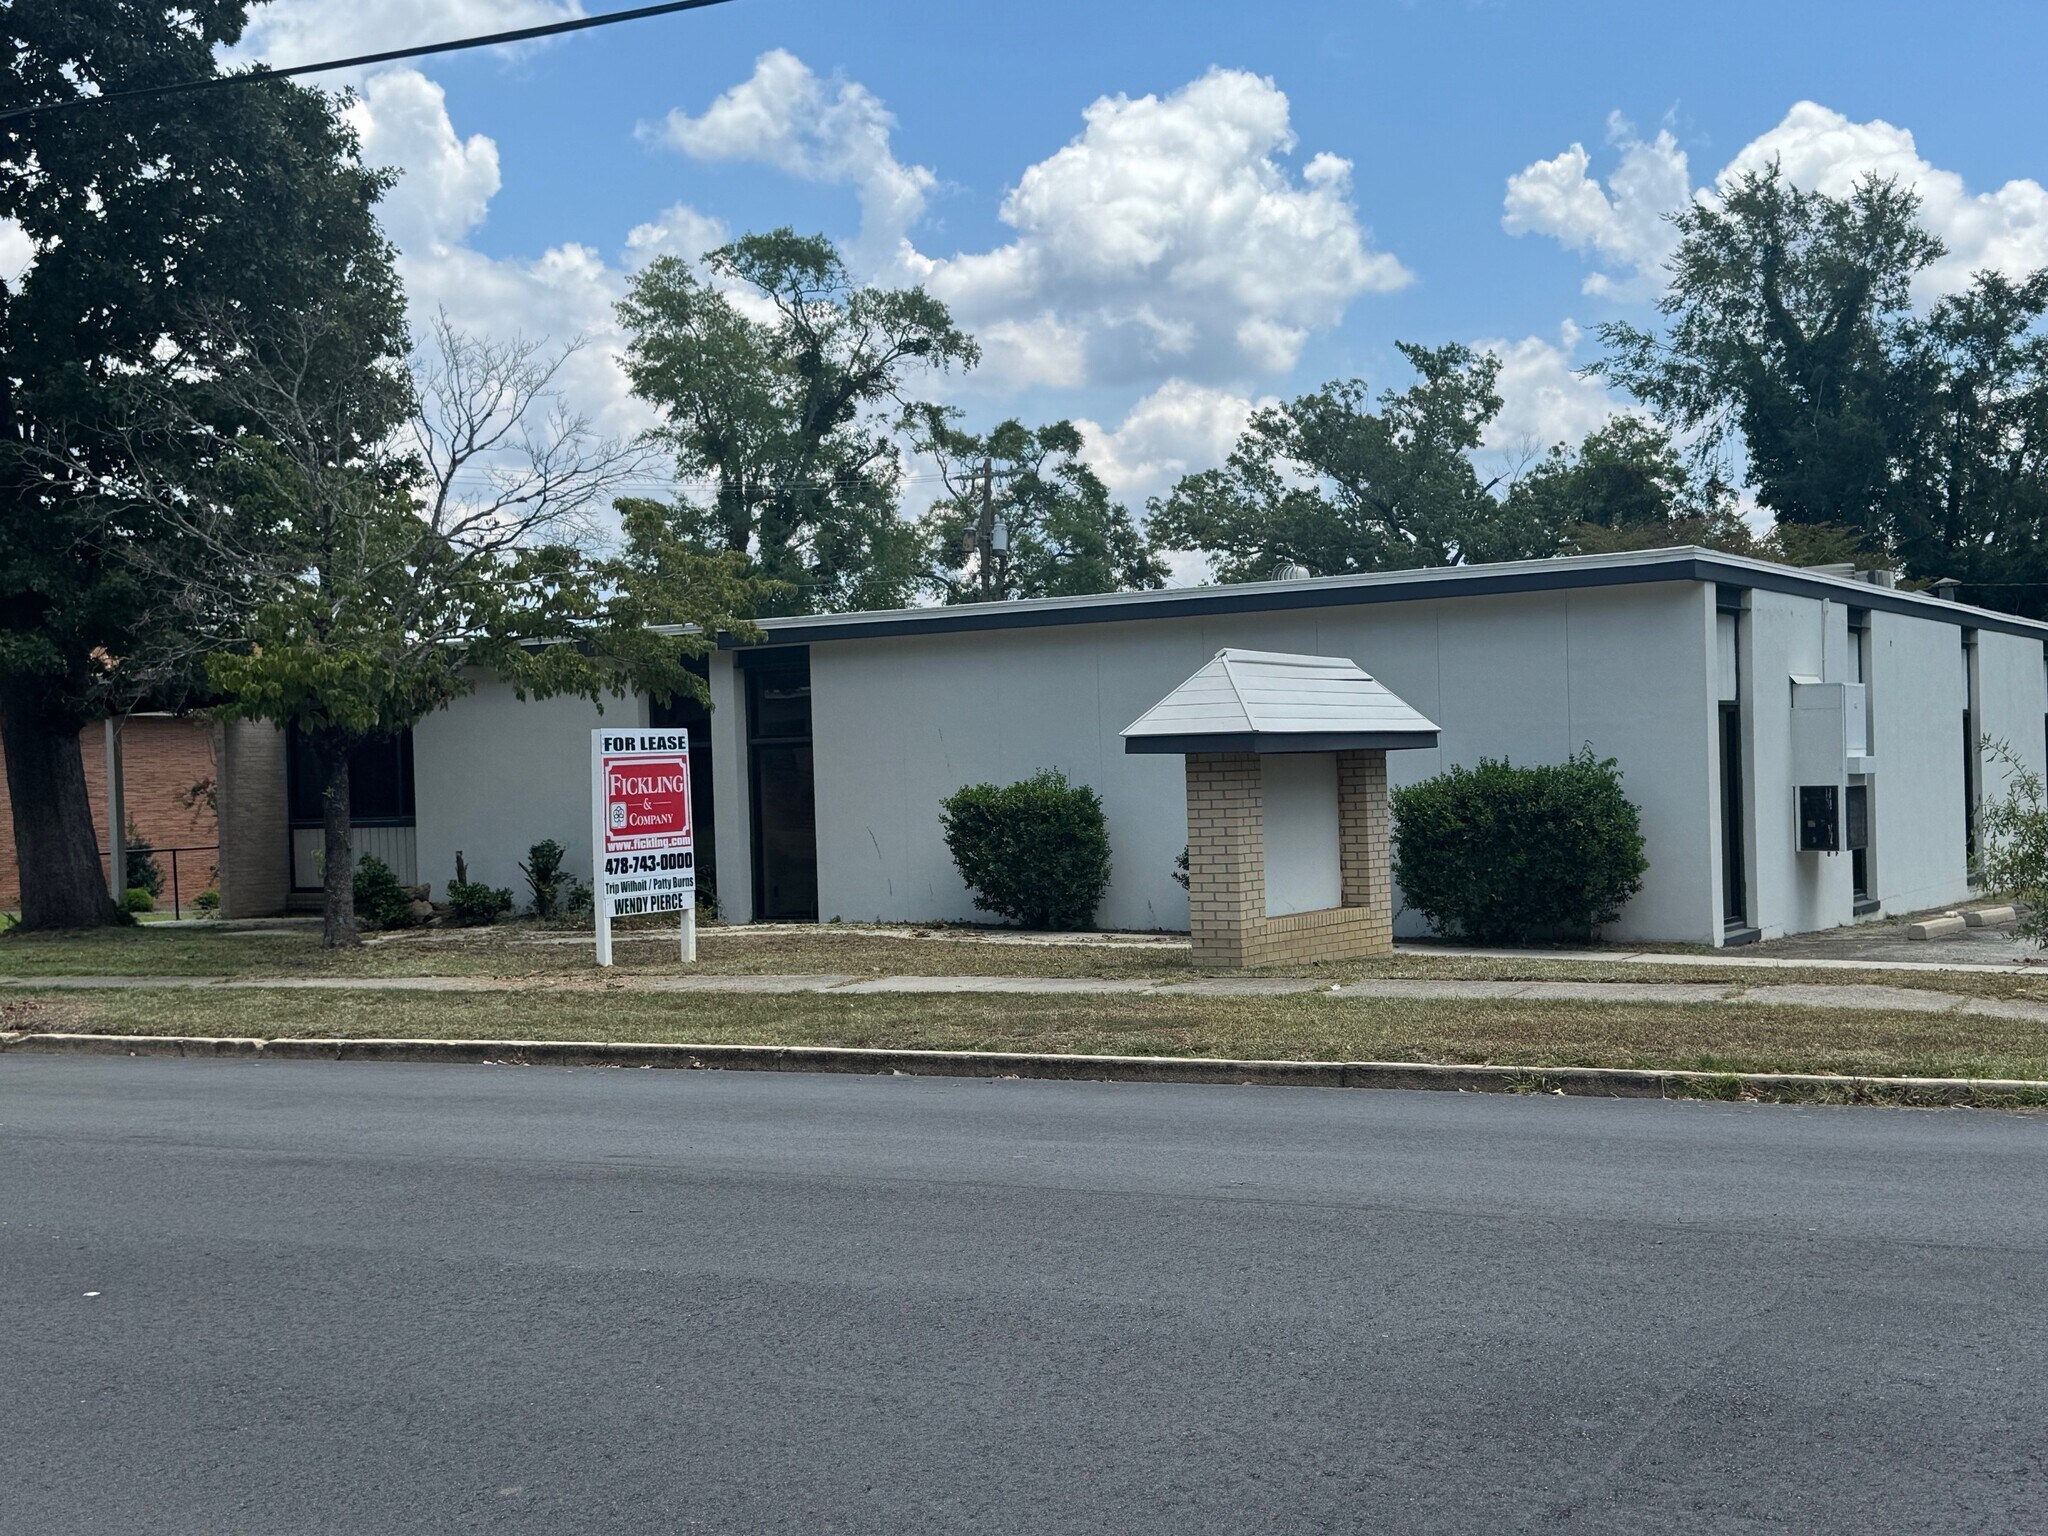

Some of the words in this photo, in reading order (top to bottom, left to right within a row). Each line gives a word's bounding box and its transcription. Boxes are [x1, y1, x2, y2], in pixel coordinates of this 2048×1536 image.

[604, 737, 635, 752] FOR
[640, 736, 686, 750] LEASE
[610, 774, 684, 796] FICKLING
[643, 797, 652, 810] &
[629, 813, 674, 826] COMPANY
[607, 837, 691, 852] www.fickling.com
[605, 852, 693, 875] 478-743-0000
[605, 882, 620, 895] Trip
[620, 880, 647, 893] Wilhoit
[653, 877, 672, 890] Patty
[673, 876, 694, 888] Burns
[614, 896, 648, 915] WENDY
[650, 893, 684, 912] PIERCE
